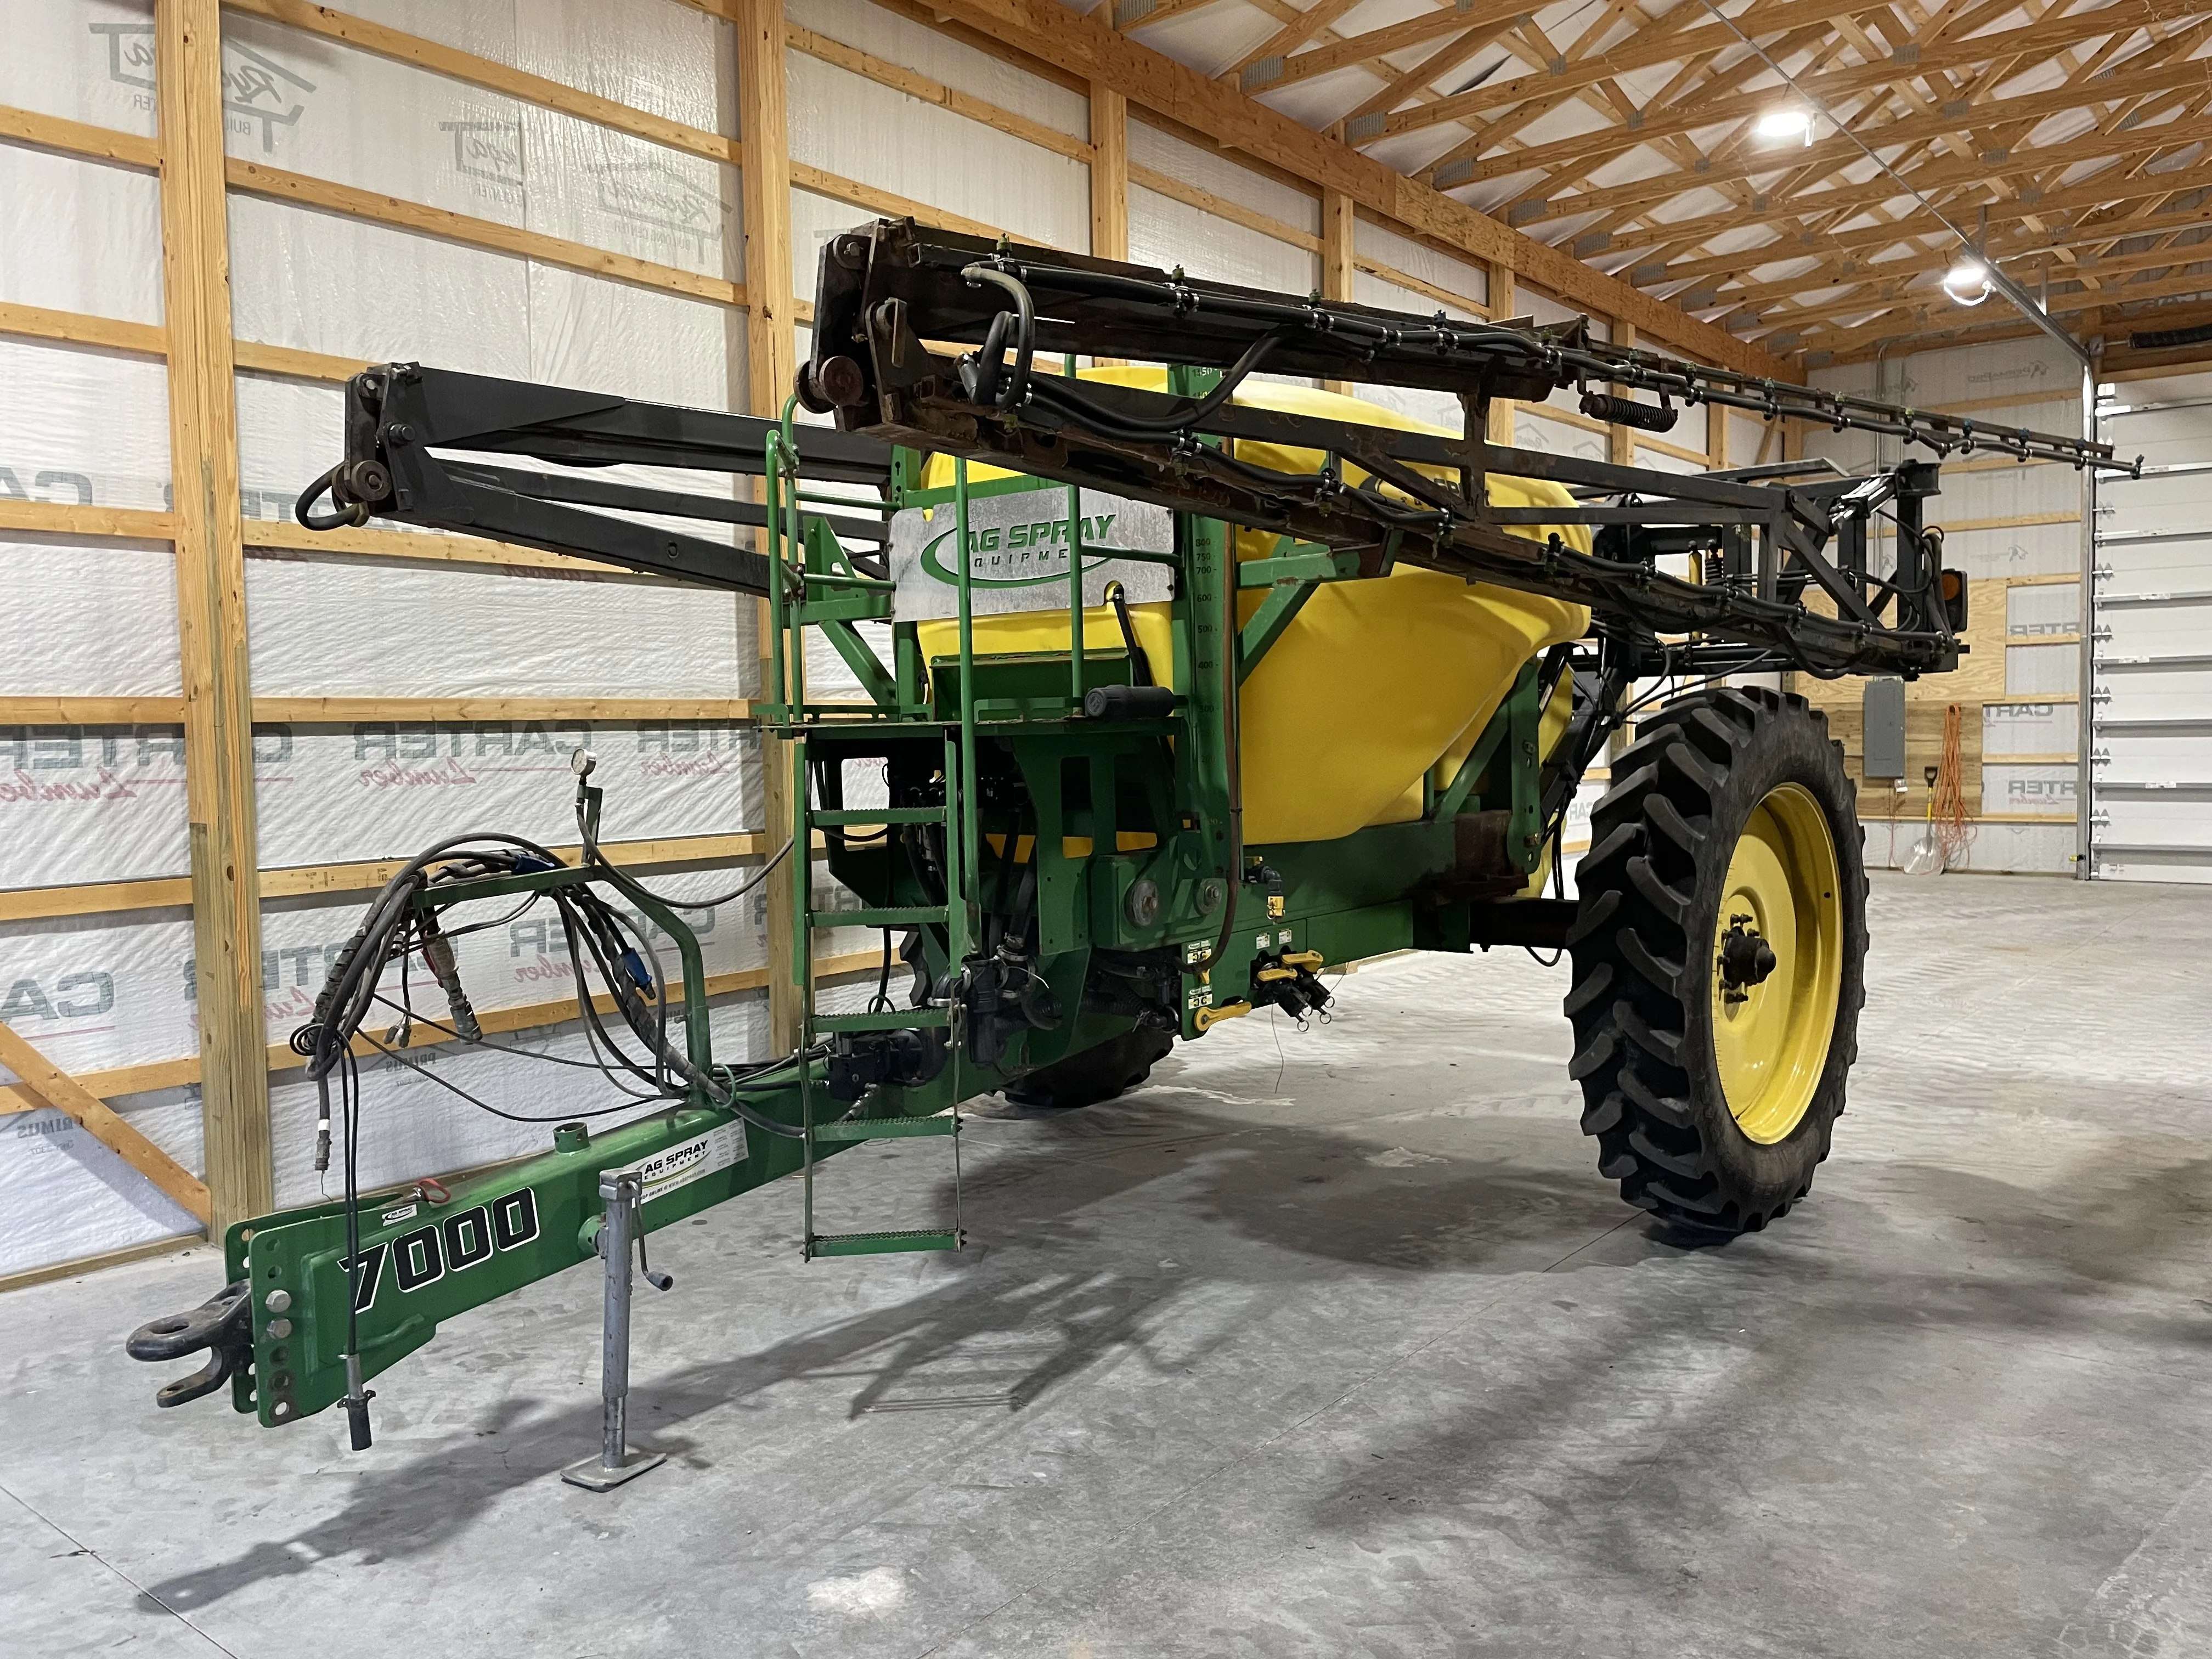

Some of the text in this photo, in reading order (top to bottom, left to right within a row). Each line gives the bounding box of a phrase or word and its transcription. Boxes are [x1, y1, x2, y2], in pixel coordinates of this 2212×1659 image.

[1007, 515, 1116, 549] SPRAY
[1196, 538, 1211, 547] 800
[974, 549, 1068, 567] QUIPME
[1197, 552, 1211, 561] 750
[1196, 566, 1211, 575] 700
[1197, 594, 1212, 602] 600
[1198, 625, 1212, 634] 500
[1198, 661, 1214, 669] 400
[644, 1159, 663, 1175] AG
[665, 1139, 708, 1165] SPRAY
[645, 1151, 706, 1180] EQUIPMENT
[337, 1187, 540, 1314] 7000
